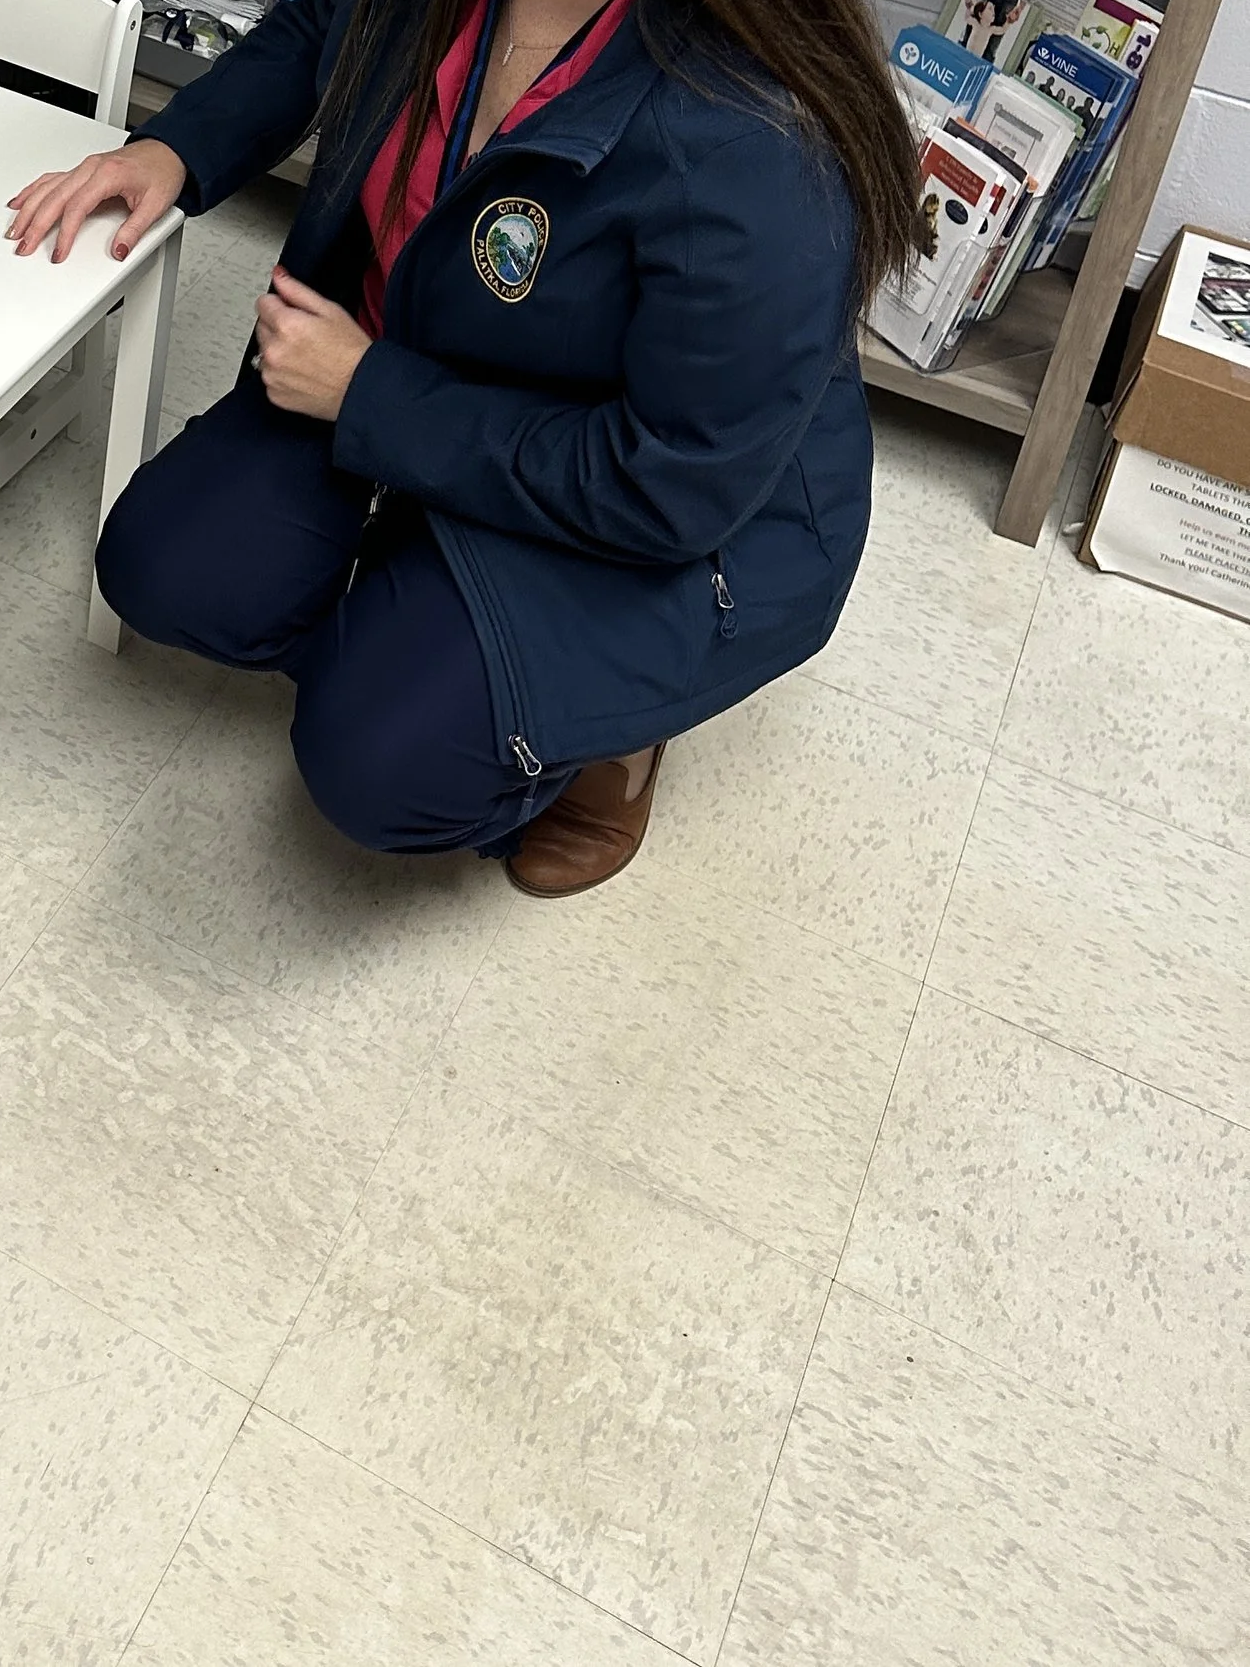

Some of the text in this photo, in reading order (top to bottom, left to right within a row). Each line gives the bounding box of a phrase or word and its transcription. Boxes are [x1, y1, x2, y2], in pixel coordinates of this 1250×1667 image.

[1051, 52, 1079, 78] VINE
[498, 202, 546, 247] CITY POLICE
[501, 280, 529, 297] FLORIDA
[1157, 458, 1244, 493] DO YOU HAVE ANY
[1150, 482, 1189, 504] LOCKED,
[1192, 482, 1230, 502] TABLETS
[1179, 518, 1201, 532] Help
[1202, 527, 1213, 536] us
[1180, 533, 1230, 557] LET ME TAKE
[1159, 552, 1186, 567] Thank
[1185, 547, 1241, 574] PLEASE PLACE
